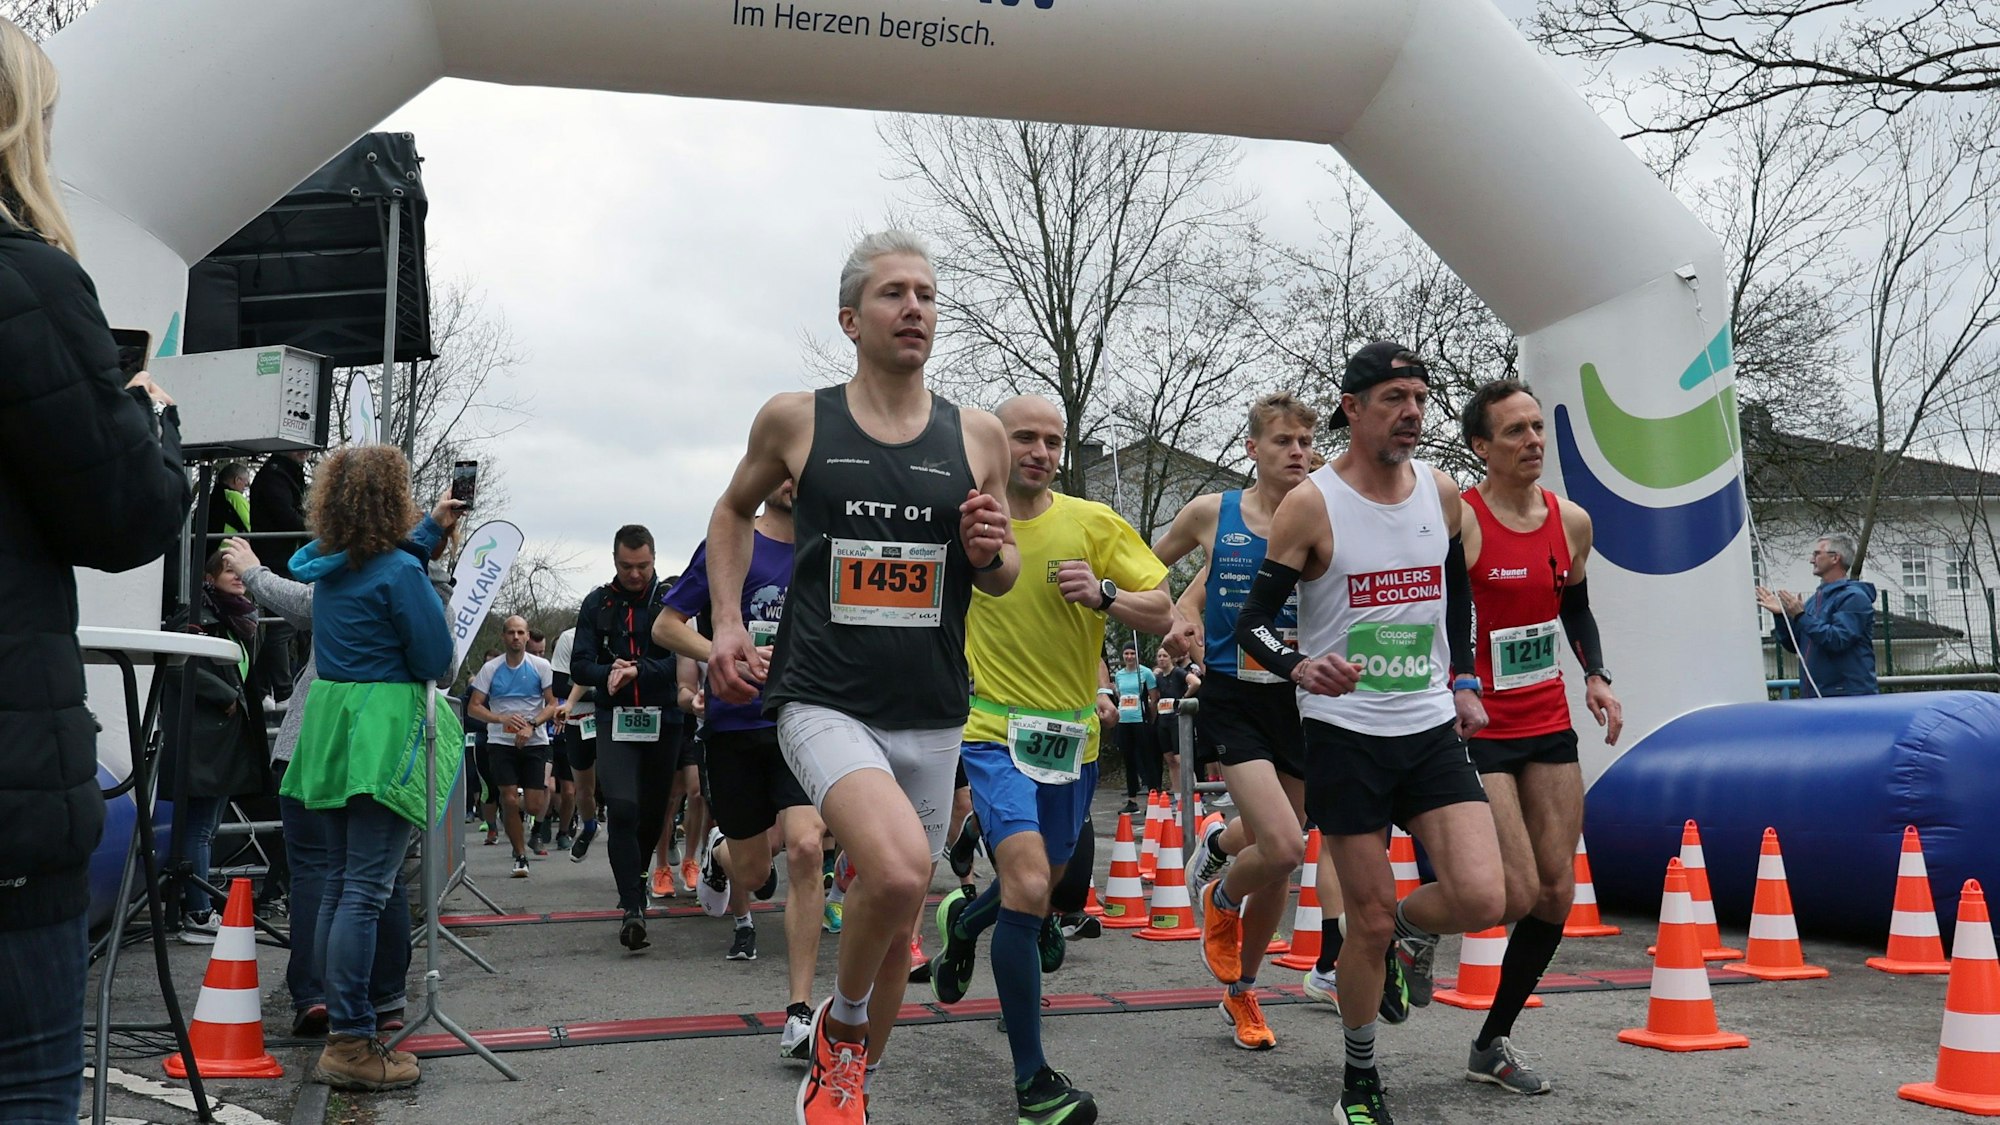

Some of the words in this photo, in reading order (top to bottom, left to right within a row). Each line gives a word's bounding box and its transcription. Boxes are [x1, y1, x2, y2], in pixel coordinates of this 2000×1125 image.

[732, 0, 764, 27] Im
[775, 2, 870, 36] Herzen
[879, 11, 995, 48] bergisch.
[845, 500, 897, 519] KTT
[904, 505, 932, 522] 01
[837, 548, 867, 557] BELKAW
[849, 560, 928, 593] 1453
[1375, 569, 1431, 587] MILERS
[1500, 568, 1528, 577] bunert
[454, 560, 502, 640] BELKAW
[1376, 584, 1441, 602] COLONIA
[1251, 625, 1283, 653] TERREX
[1380, 630, 1418, 639] COLOGNE
[1505, 636, 1552, 664] 1214
[1350, 652, 1429, 678] 20680
[624, 715, 651, 727] 585
[1026, 732, 1068, 759] 370
